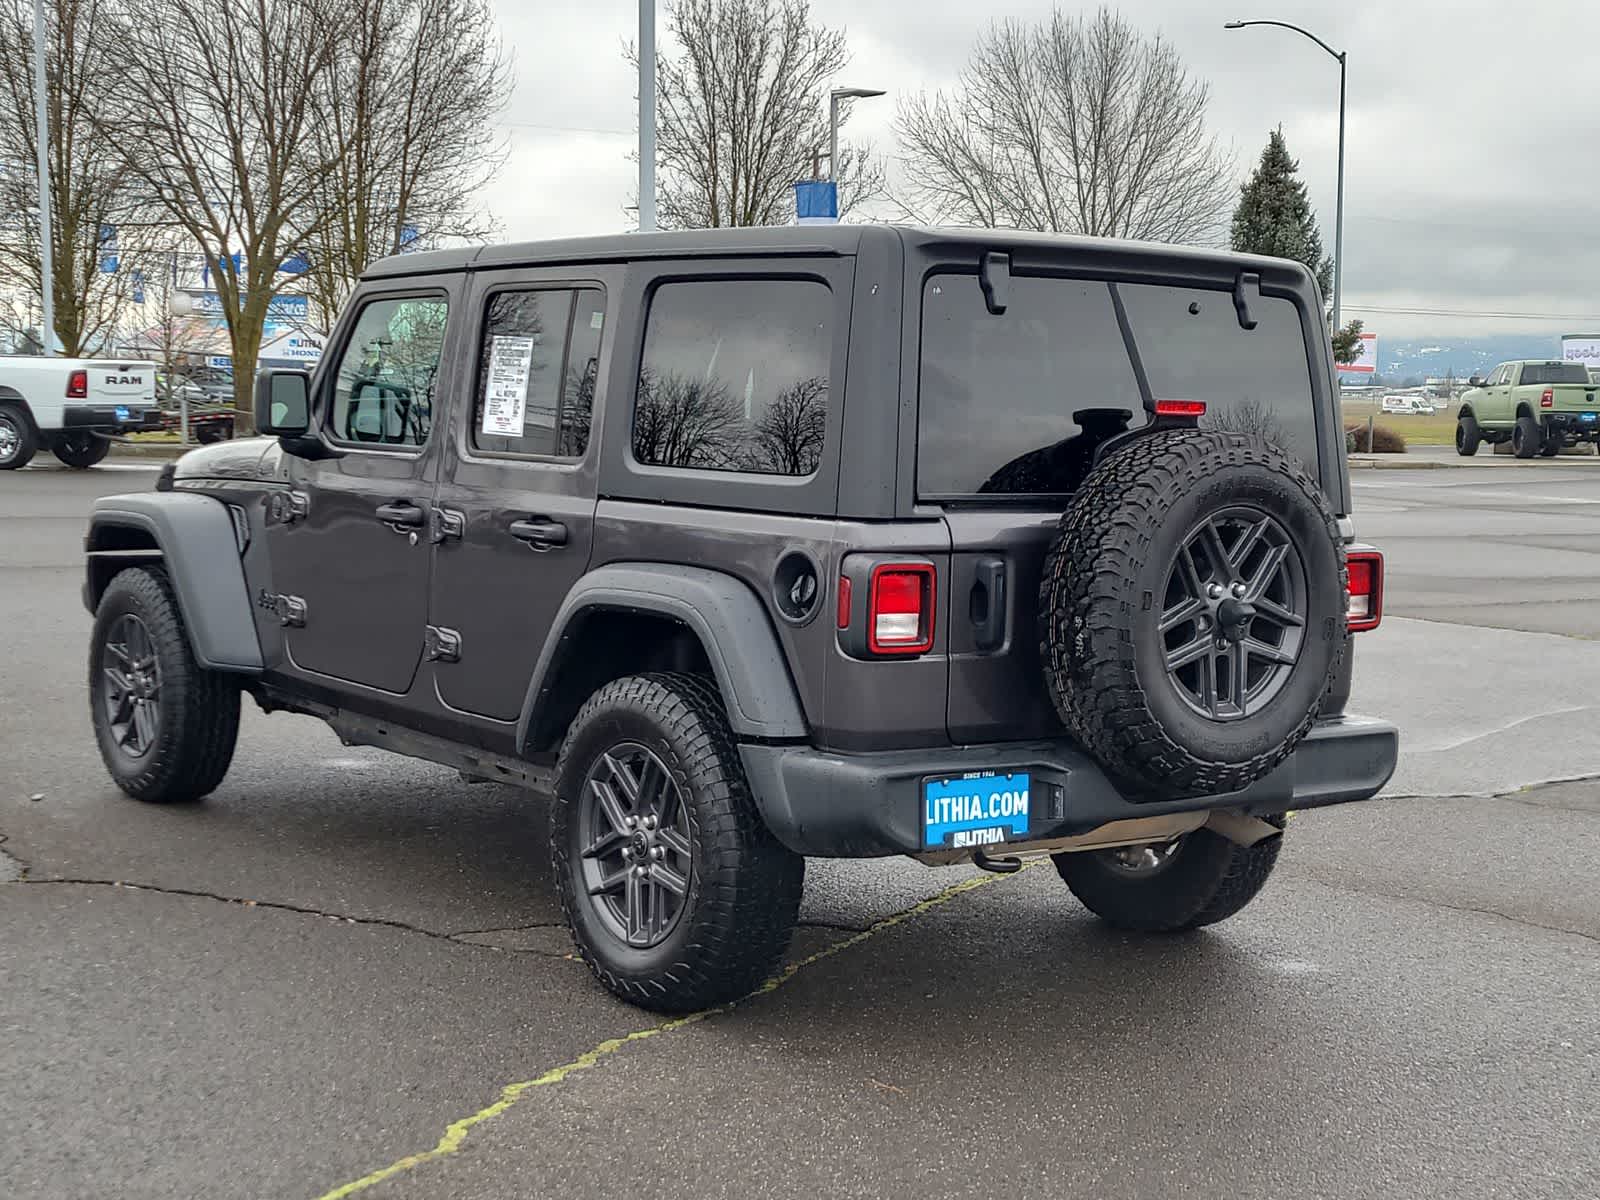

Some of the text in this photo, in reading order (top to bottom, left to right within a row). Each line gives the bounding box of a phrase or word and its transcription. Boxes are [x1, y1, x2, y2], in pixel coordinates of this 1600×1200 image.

[105, 376, 142, 385] RAM
[926, 790, 1029, 825] LITHIA.COM
[965, 826, 1005, 847] LITHIA
